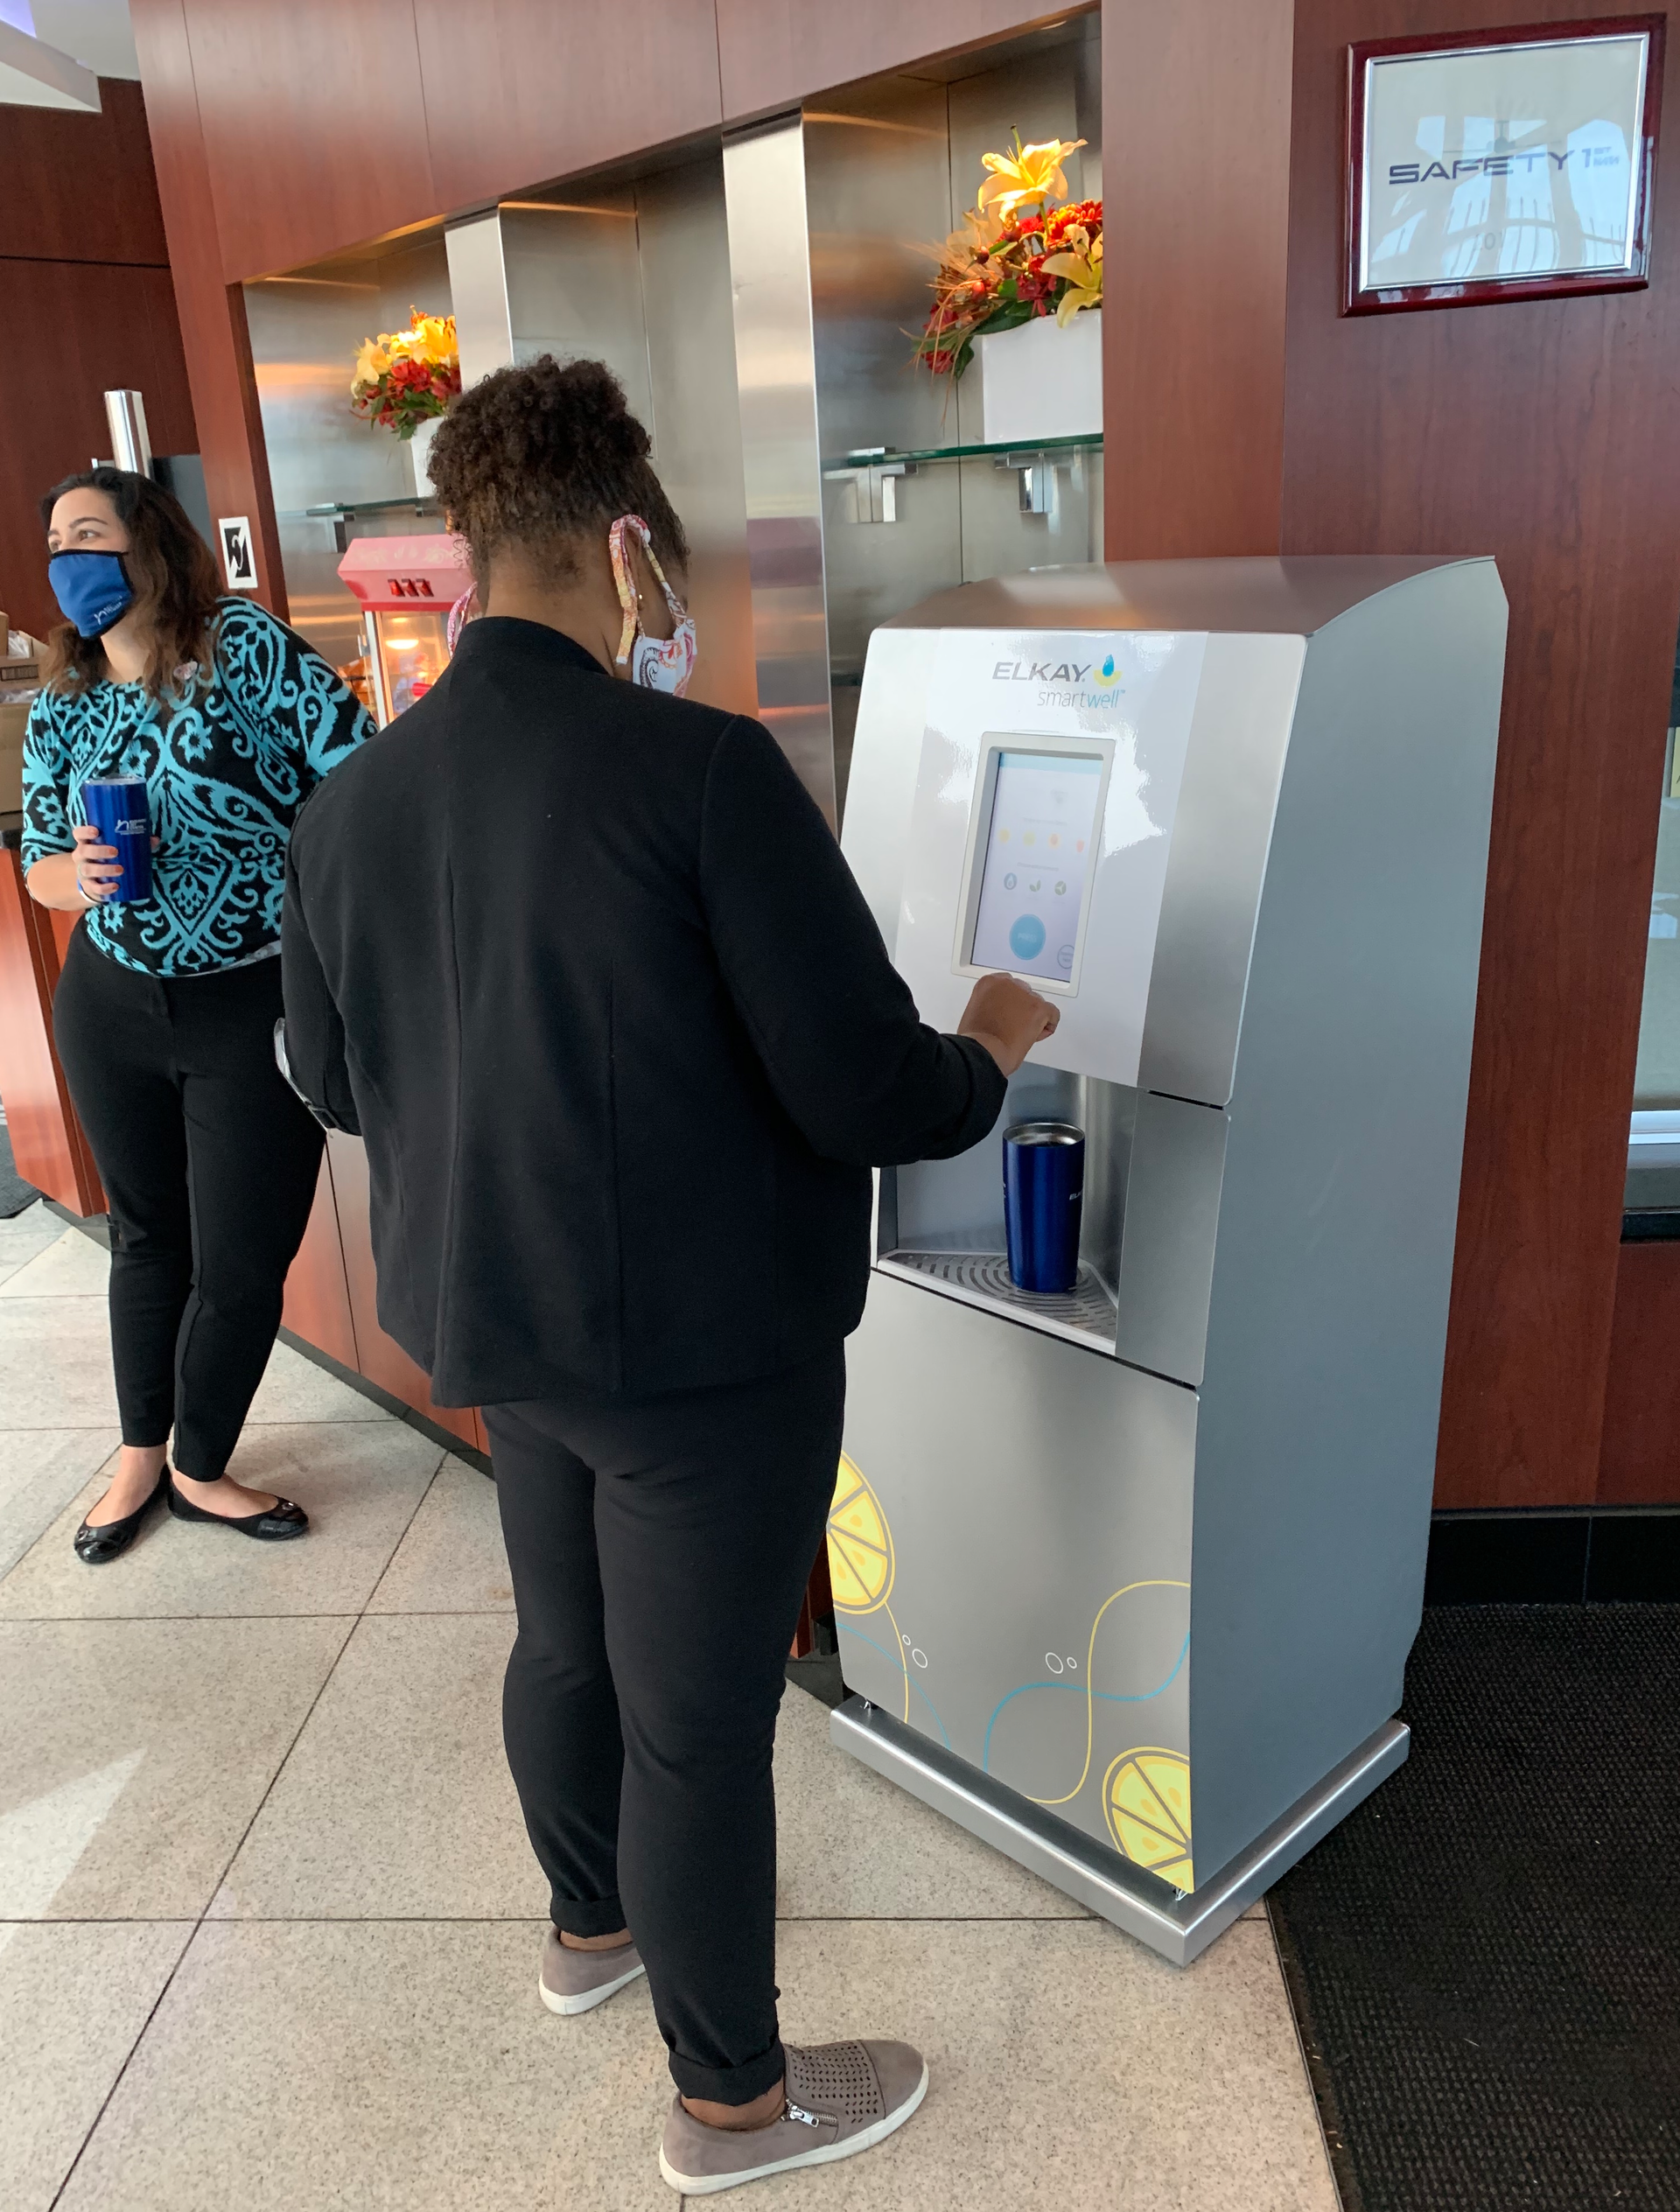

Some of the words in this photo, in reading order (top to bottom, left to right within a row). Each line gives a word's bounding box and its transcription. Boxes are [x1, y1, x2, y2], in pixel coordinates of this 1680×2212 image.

[1389, 150, 1575, 185] SAFETY
[992, 662, 1092, 682] ELKAY
[1037, 689, 1121, 710] smartwell
